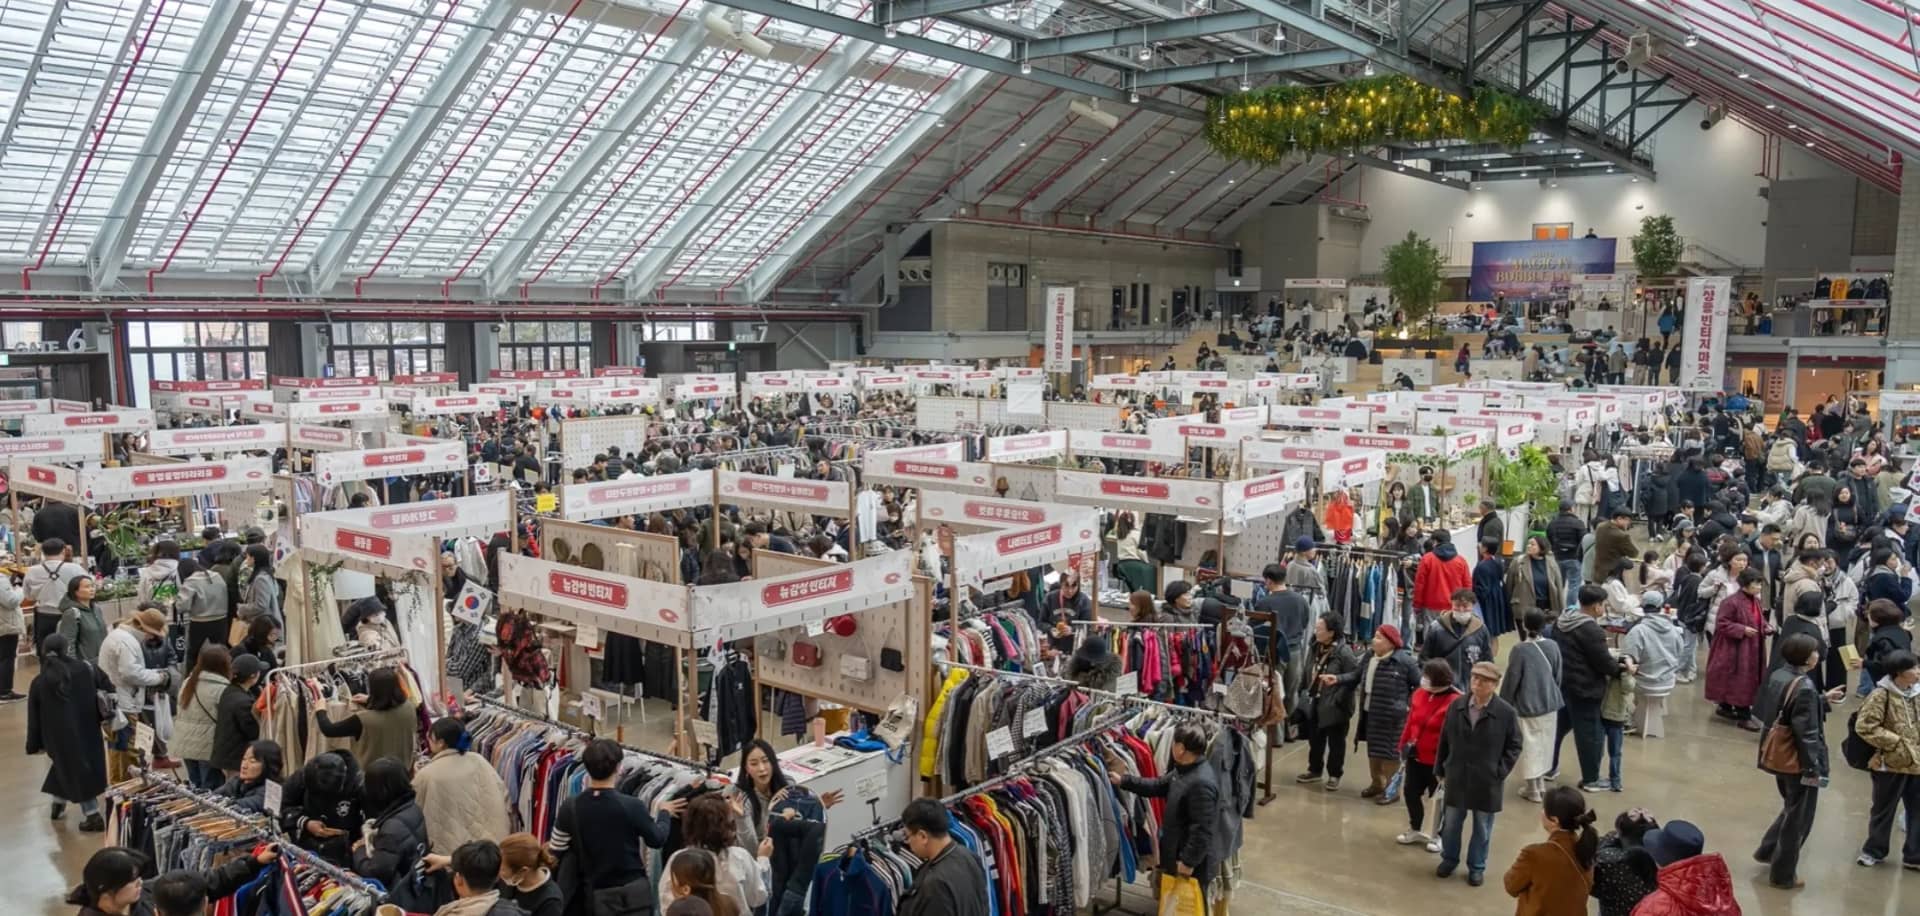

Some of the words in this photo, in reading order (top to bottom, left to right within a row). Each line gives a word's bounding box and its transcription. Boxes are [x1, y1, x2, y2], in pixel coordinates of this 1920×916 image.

[15, 341, 59, 353] GATE
[67, 328, 87, 353] 6
[562, 577, 613, 601] 뉴감성빈티지
[780, 575, 838, 599] 뉴감성빈티지
